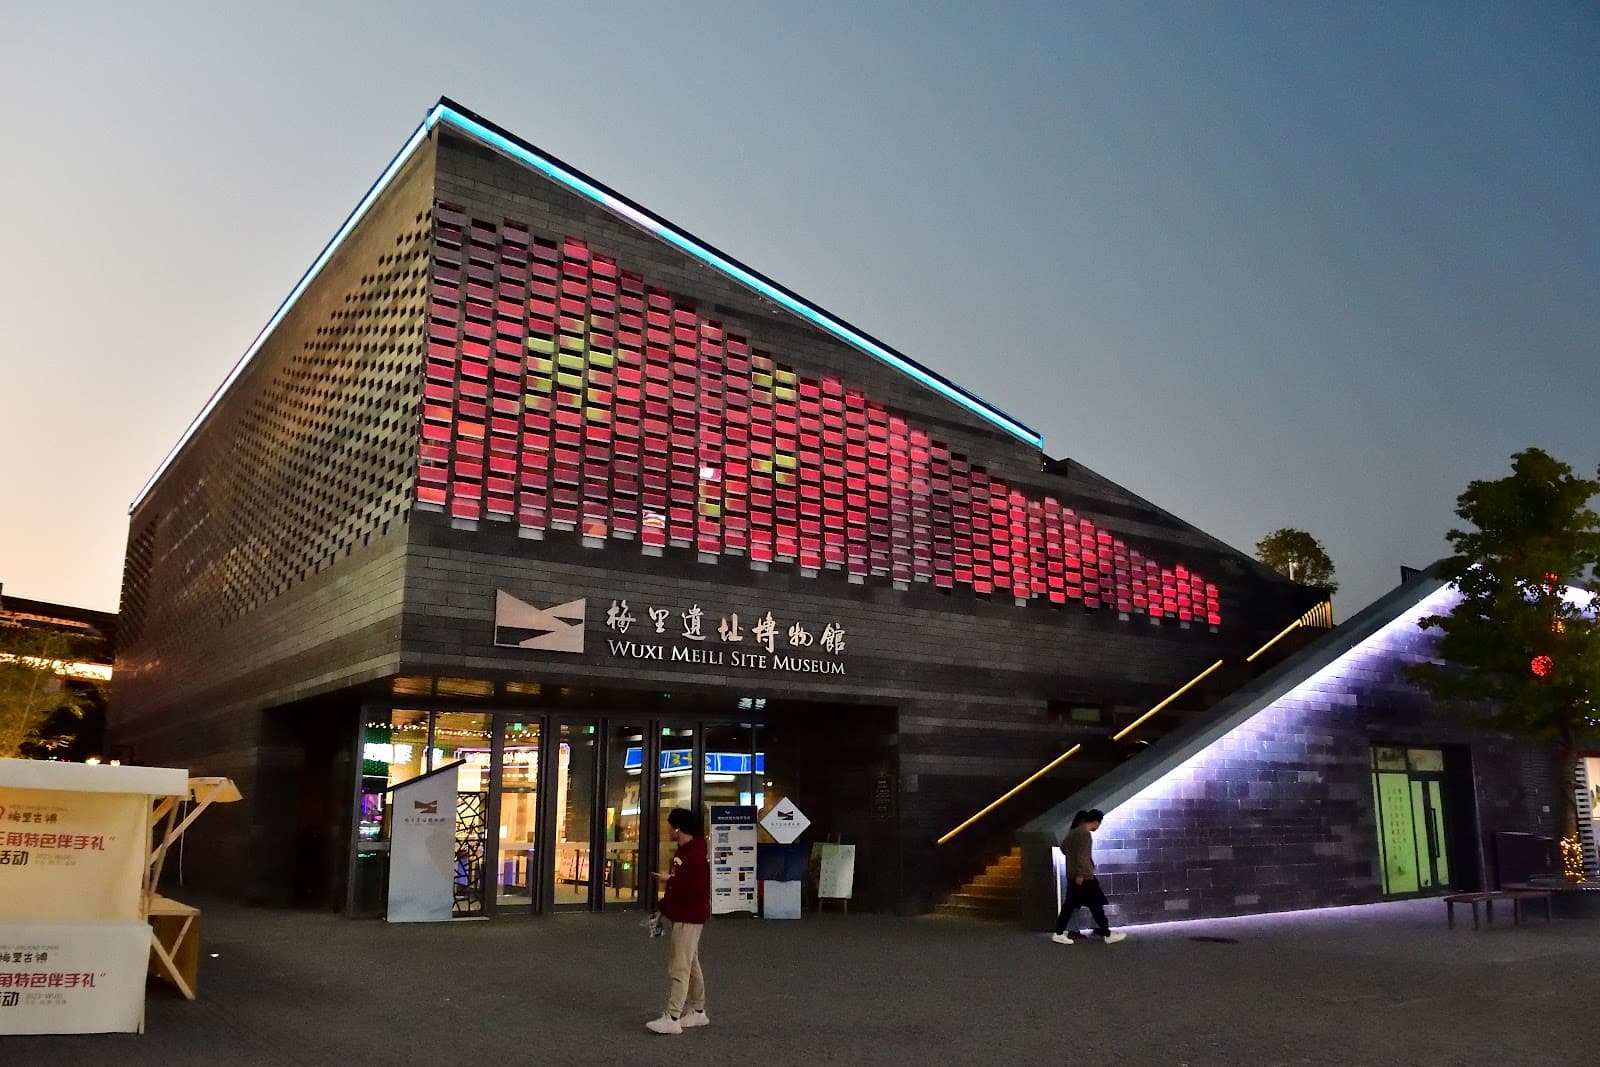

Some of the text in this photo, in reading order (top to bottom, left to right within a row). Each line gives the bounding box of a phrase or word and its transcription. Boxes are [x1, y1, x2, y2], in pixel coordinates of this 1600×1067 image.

[606, 599, 846, 655] 梅里遺址博物館
[608, 639, 846, 675] WUXI MEILI SITE MUSEUM
[0, 991, 20, 1007] 动
